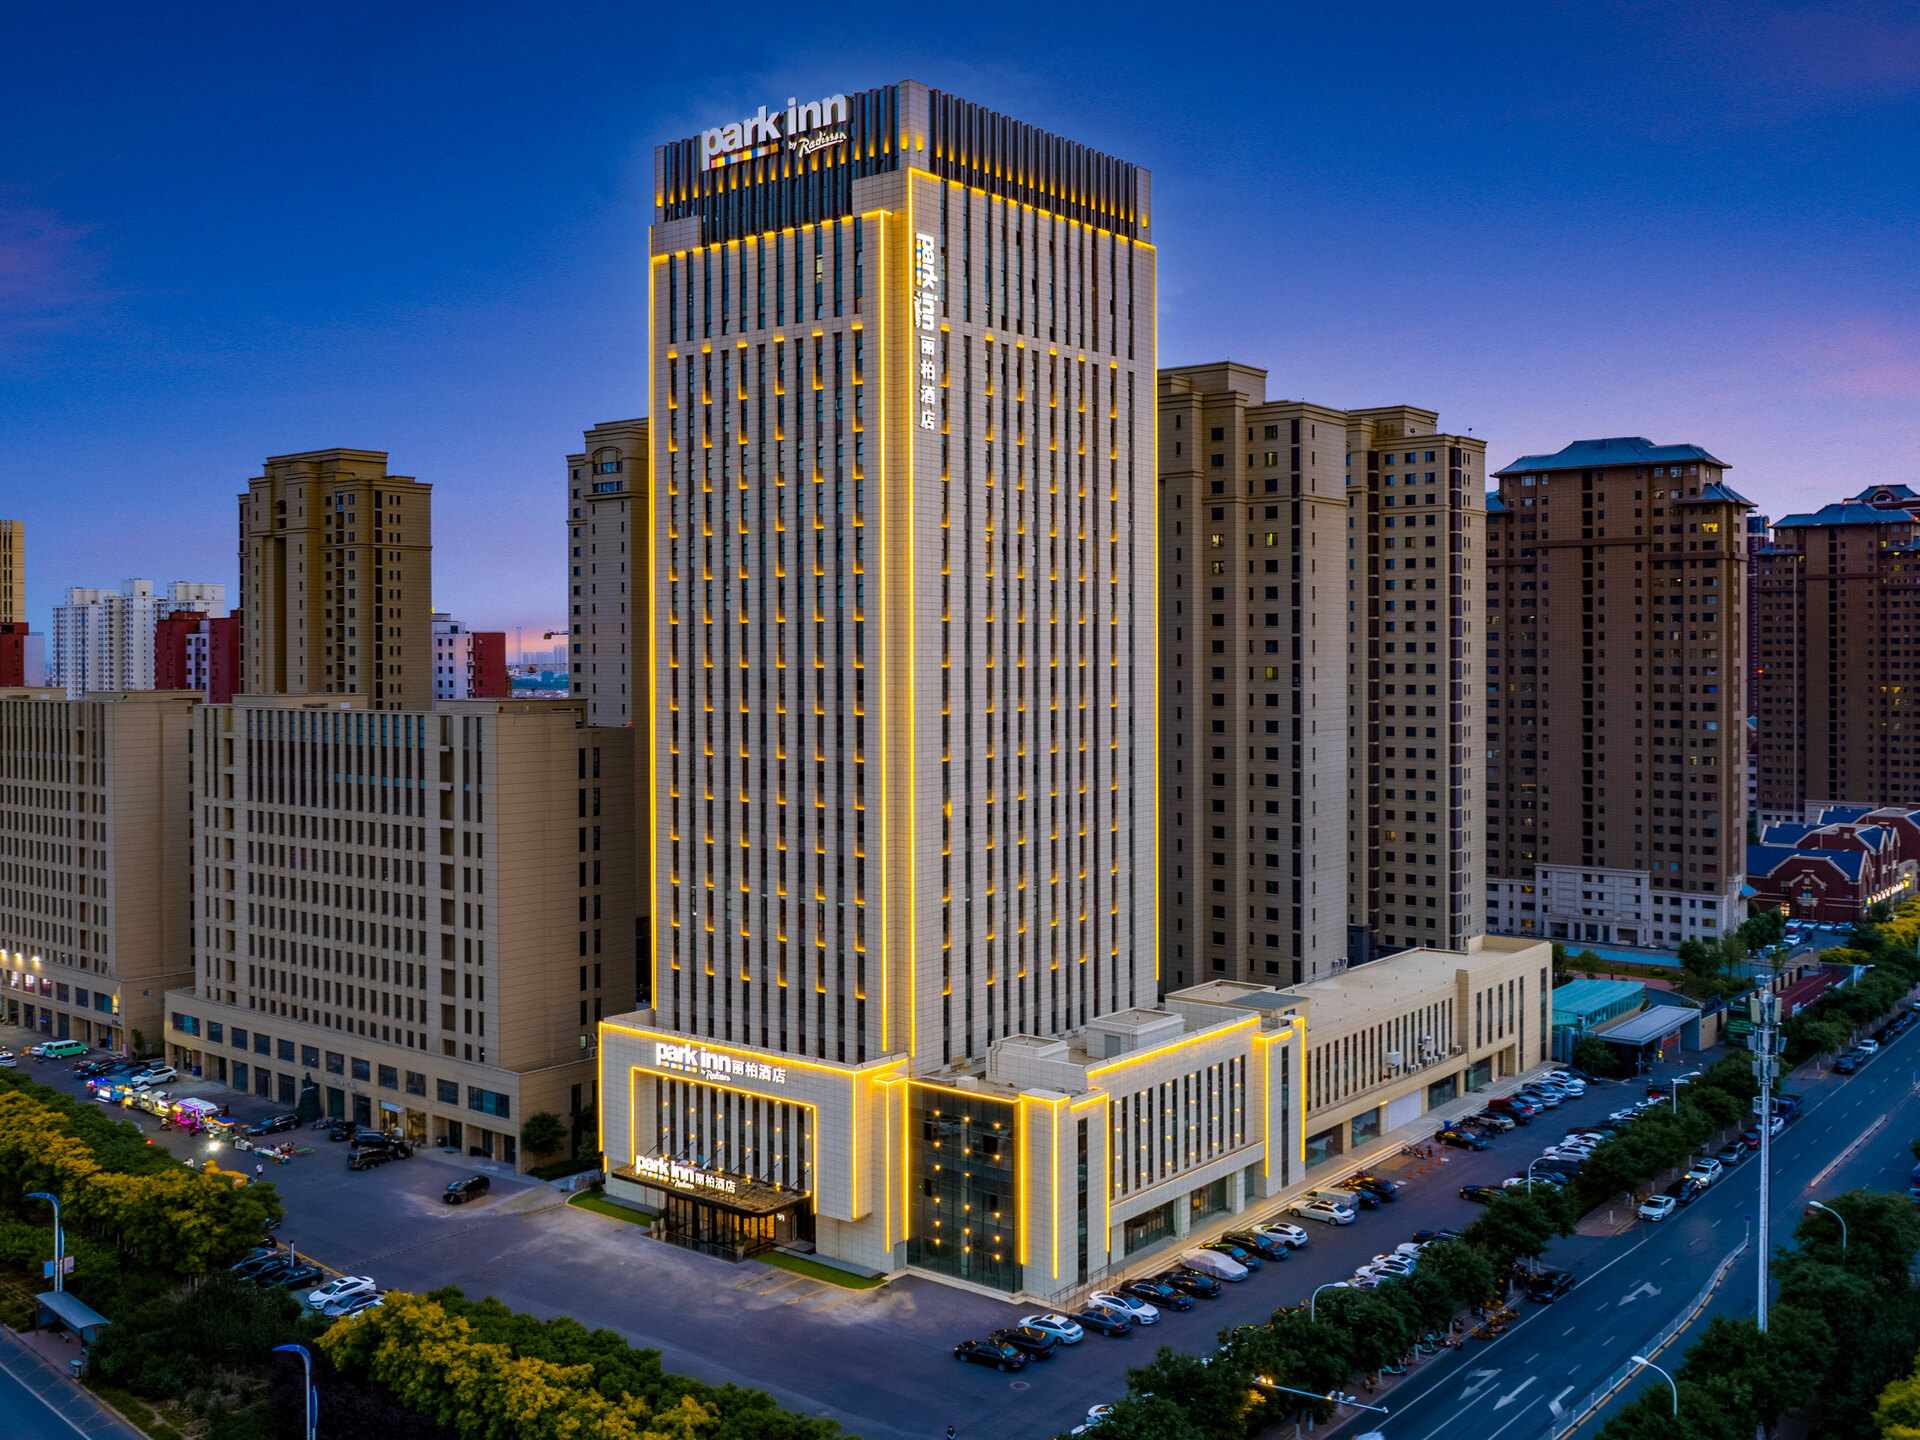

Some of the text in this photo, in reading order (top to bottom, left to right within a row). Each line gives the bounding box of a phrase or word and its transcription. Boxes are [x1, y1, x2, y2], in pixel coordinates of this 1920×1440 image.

[701, 94, 847, 171] park inn
[788, 140, 797, 150] by
[916, 232, 938, 331] park inn
[920, 335, 936, 430] 丽柏酒店
[655, 1042, 732, 1073] park inn
[732, 1059, 787, 1084] 丽柏酒店
[635, 1155, 695, 1183] park inn
[695, 1172, 736, 1194] 丽柏酒店
